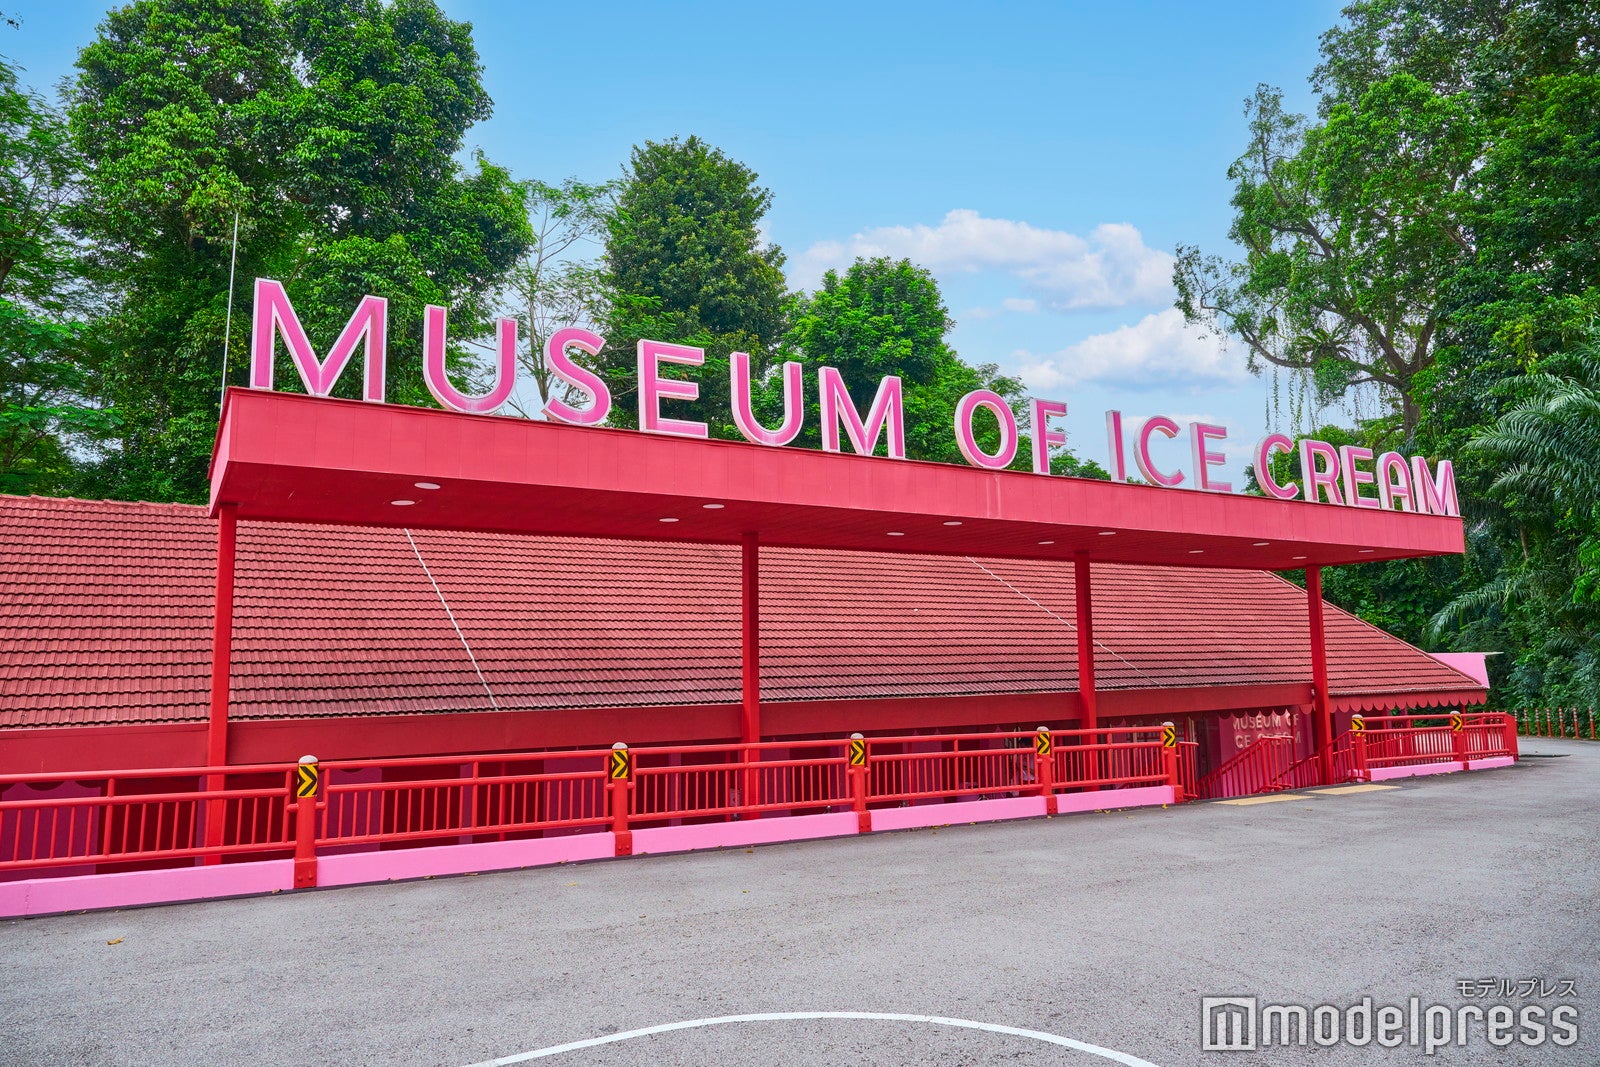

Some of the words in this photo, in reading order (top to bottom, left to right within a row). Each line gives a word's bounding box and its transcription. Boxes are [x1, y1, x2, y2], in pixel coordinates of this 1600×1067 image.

[250, 277, 906, 460] MUSEUM
[953, 388, 1068, 475] OF
[1106, 409, 1233, 493] ICE
[1253, 433, 1460, 517] CREAM
